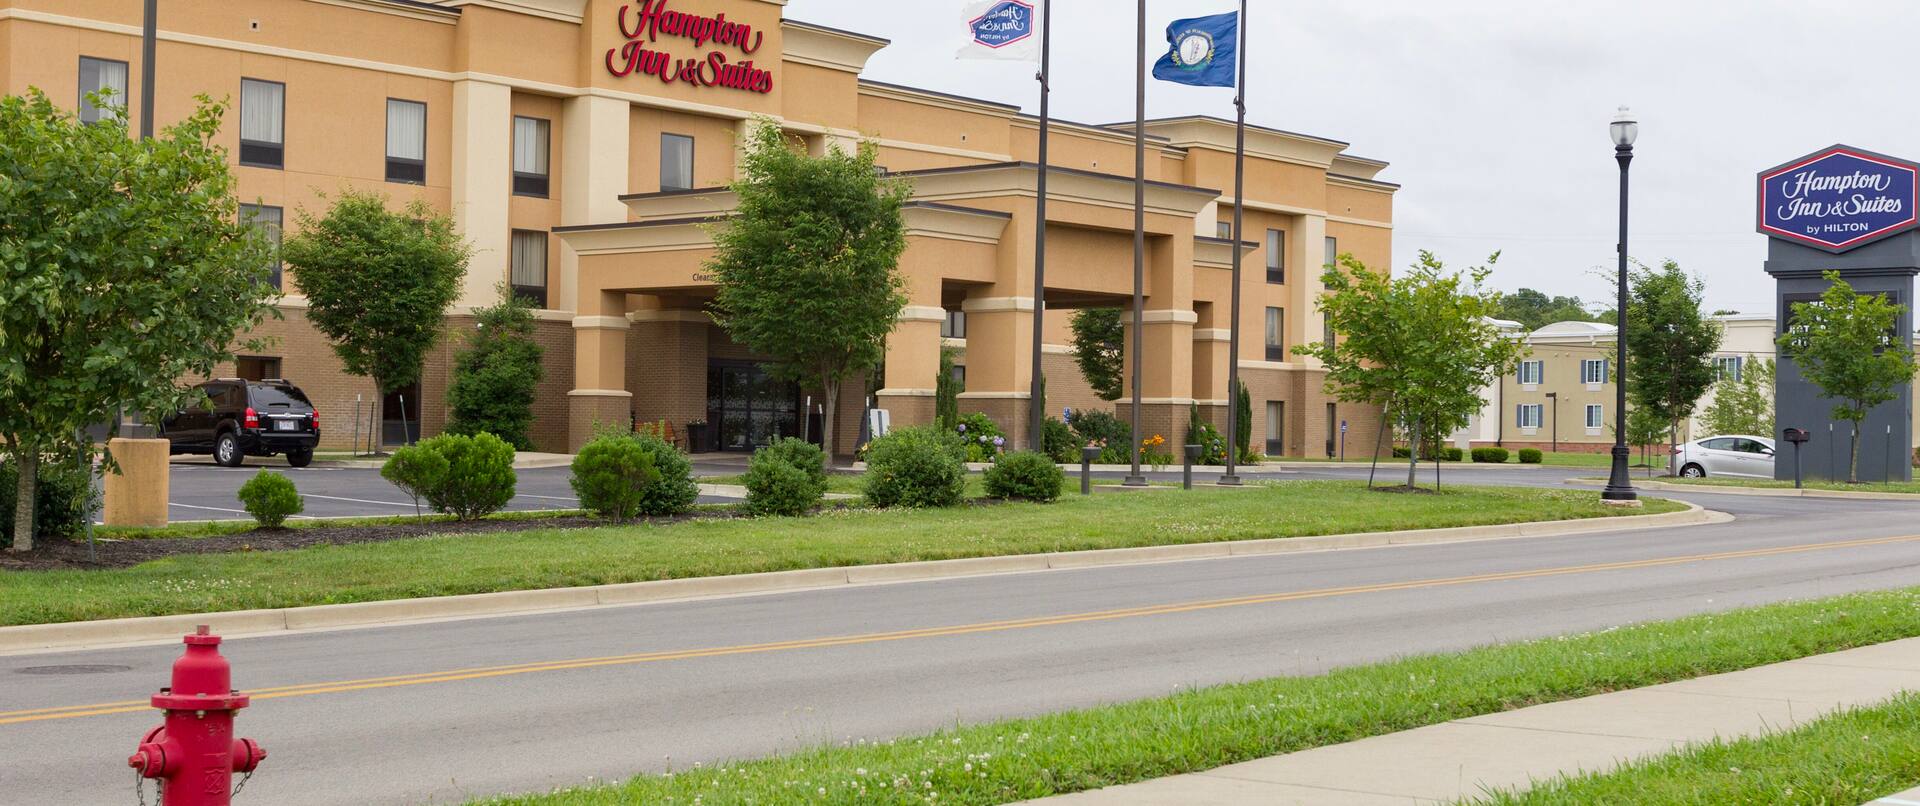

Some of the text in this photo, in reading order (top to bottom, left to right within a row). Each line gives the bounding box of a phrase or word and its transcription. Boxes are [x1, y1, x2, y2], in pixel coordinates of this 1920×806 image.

[618, 0, 763, 54] Hampton
[606, 39, 773, 94] Inn & Suites
[1782, 170, 1891, 199] Hampton
[1777, 194, 1902, 221] Inn & Suites
[1806, 222, 1869, 235] by HILTON
